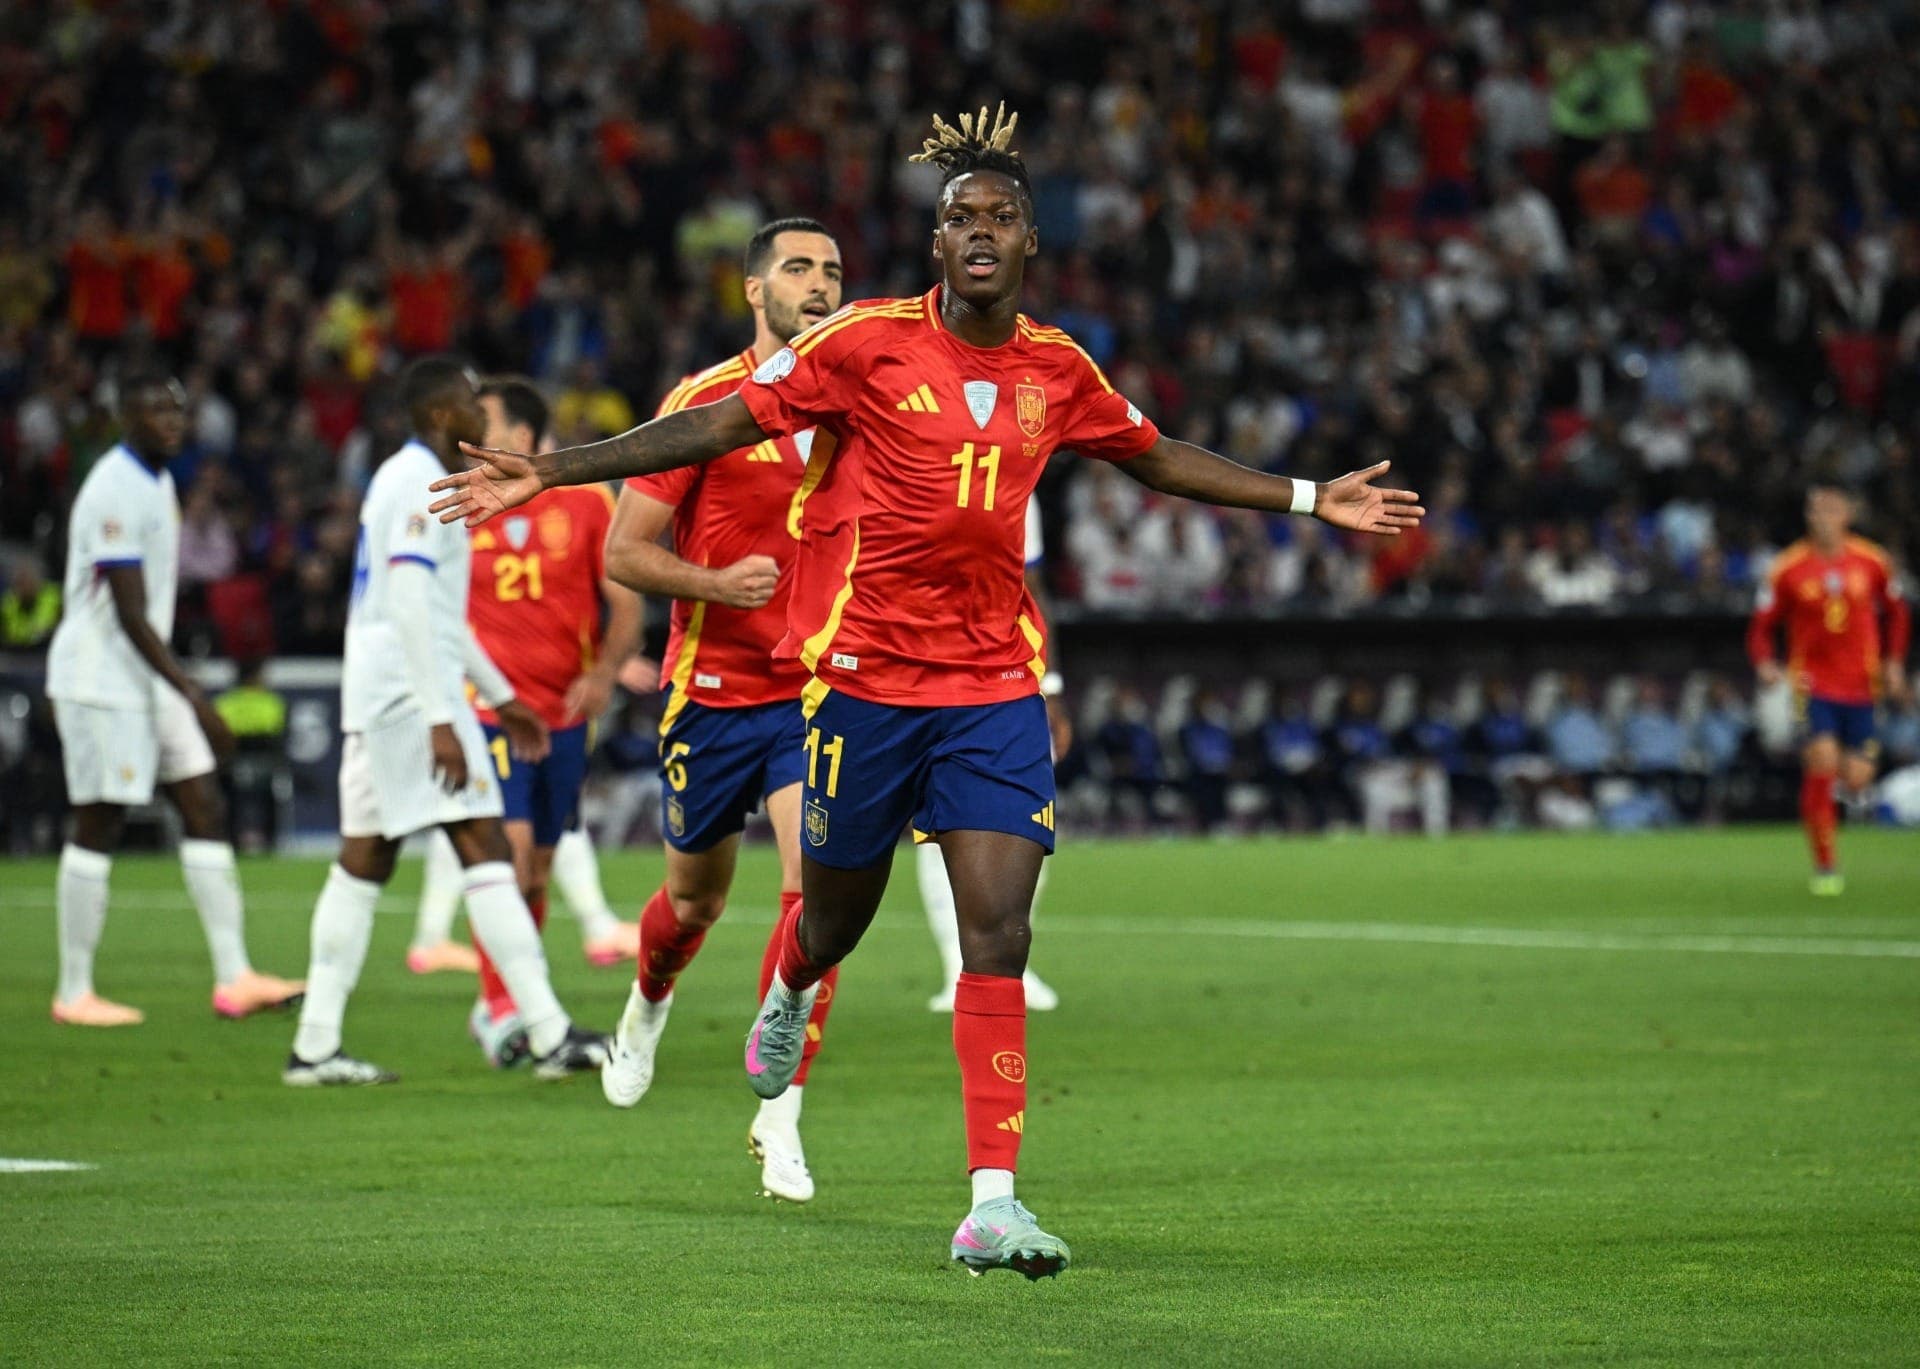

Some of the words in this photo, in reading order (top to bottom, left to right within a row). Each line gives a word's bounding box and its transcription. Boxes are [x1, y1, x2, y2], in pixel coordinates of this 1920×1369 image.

[951, 442, 1001, 511] 11
[493, 553, 543, 601] 21
[489, 735, 511, 781] 1
[664, 741, 690, 792] 6
[802, 727, 844, 798] 11
